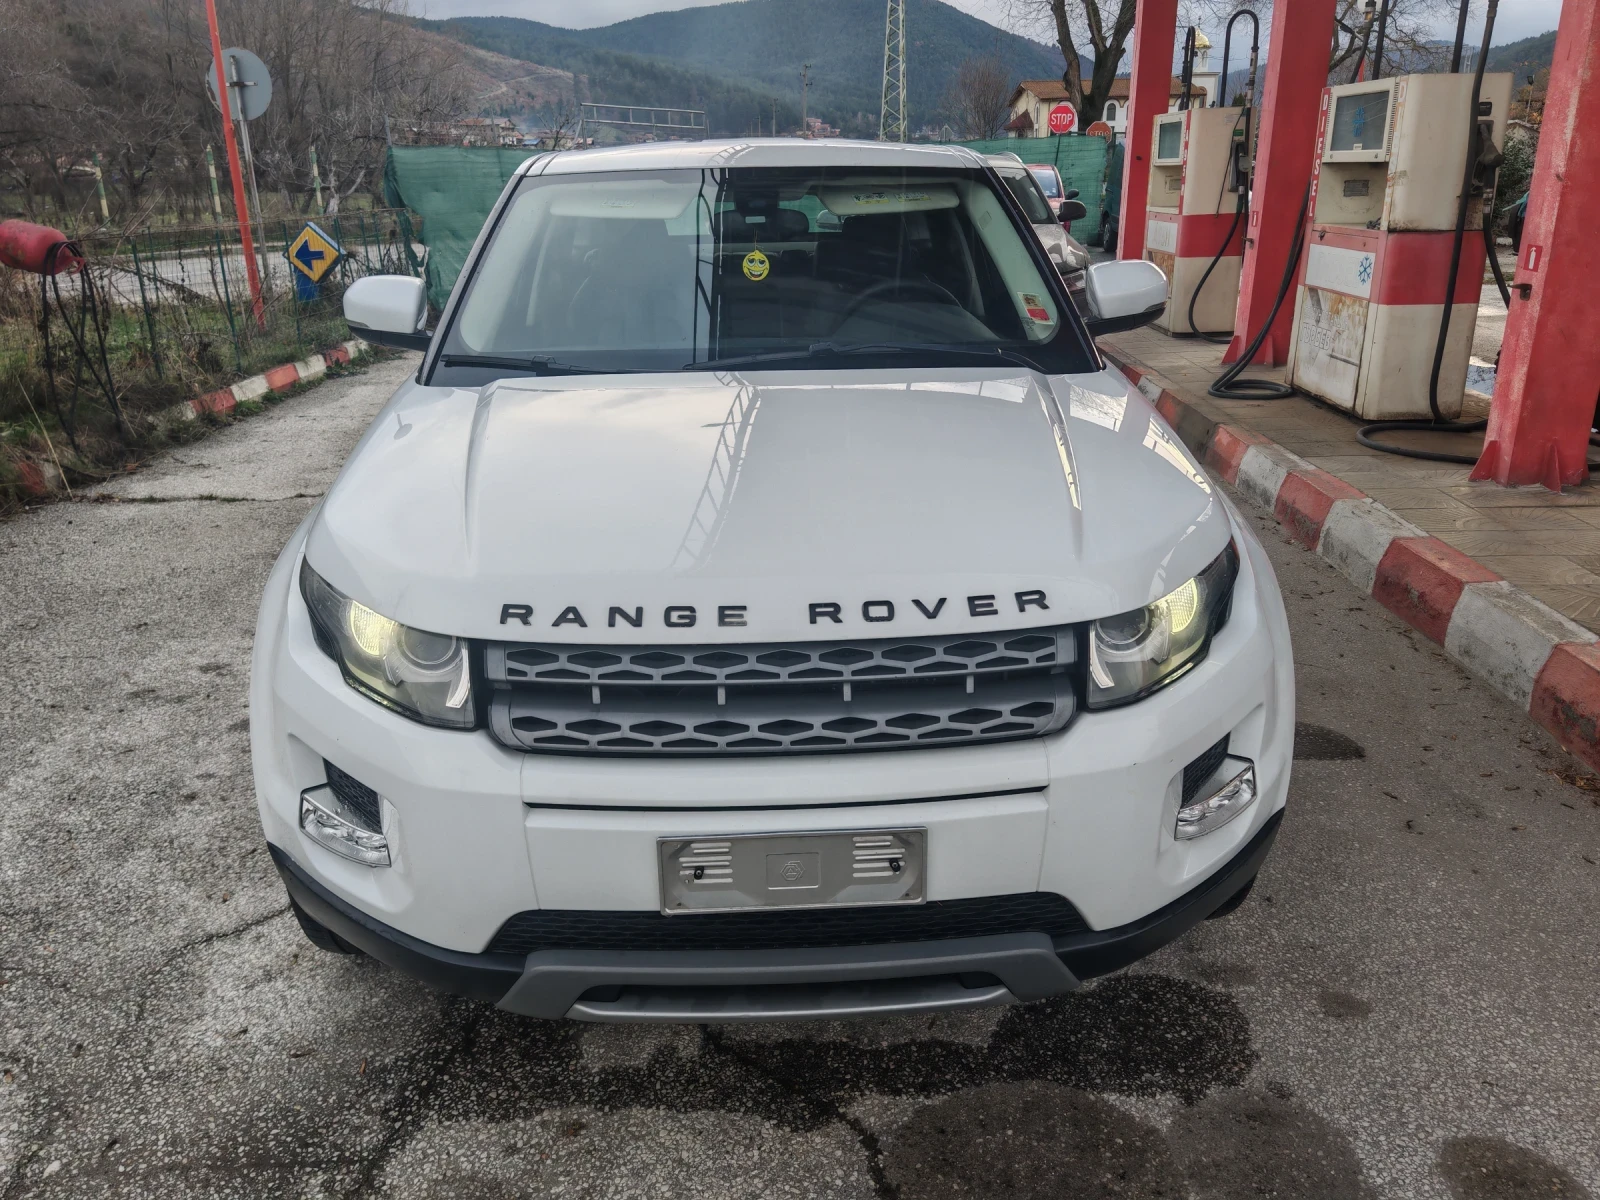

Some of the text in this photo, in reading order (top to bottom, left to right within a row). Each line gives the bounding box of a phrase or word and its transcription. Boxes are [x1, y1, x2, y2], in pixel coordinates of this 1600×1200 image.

[1050, 113, 1073, 125] STOP
[1308, 94, 1329, 217] DIESEL
[500, 589, 1050, 628] RANGE ROVER
